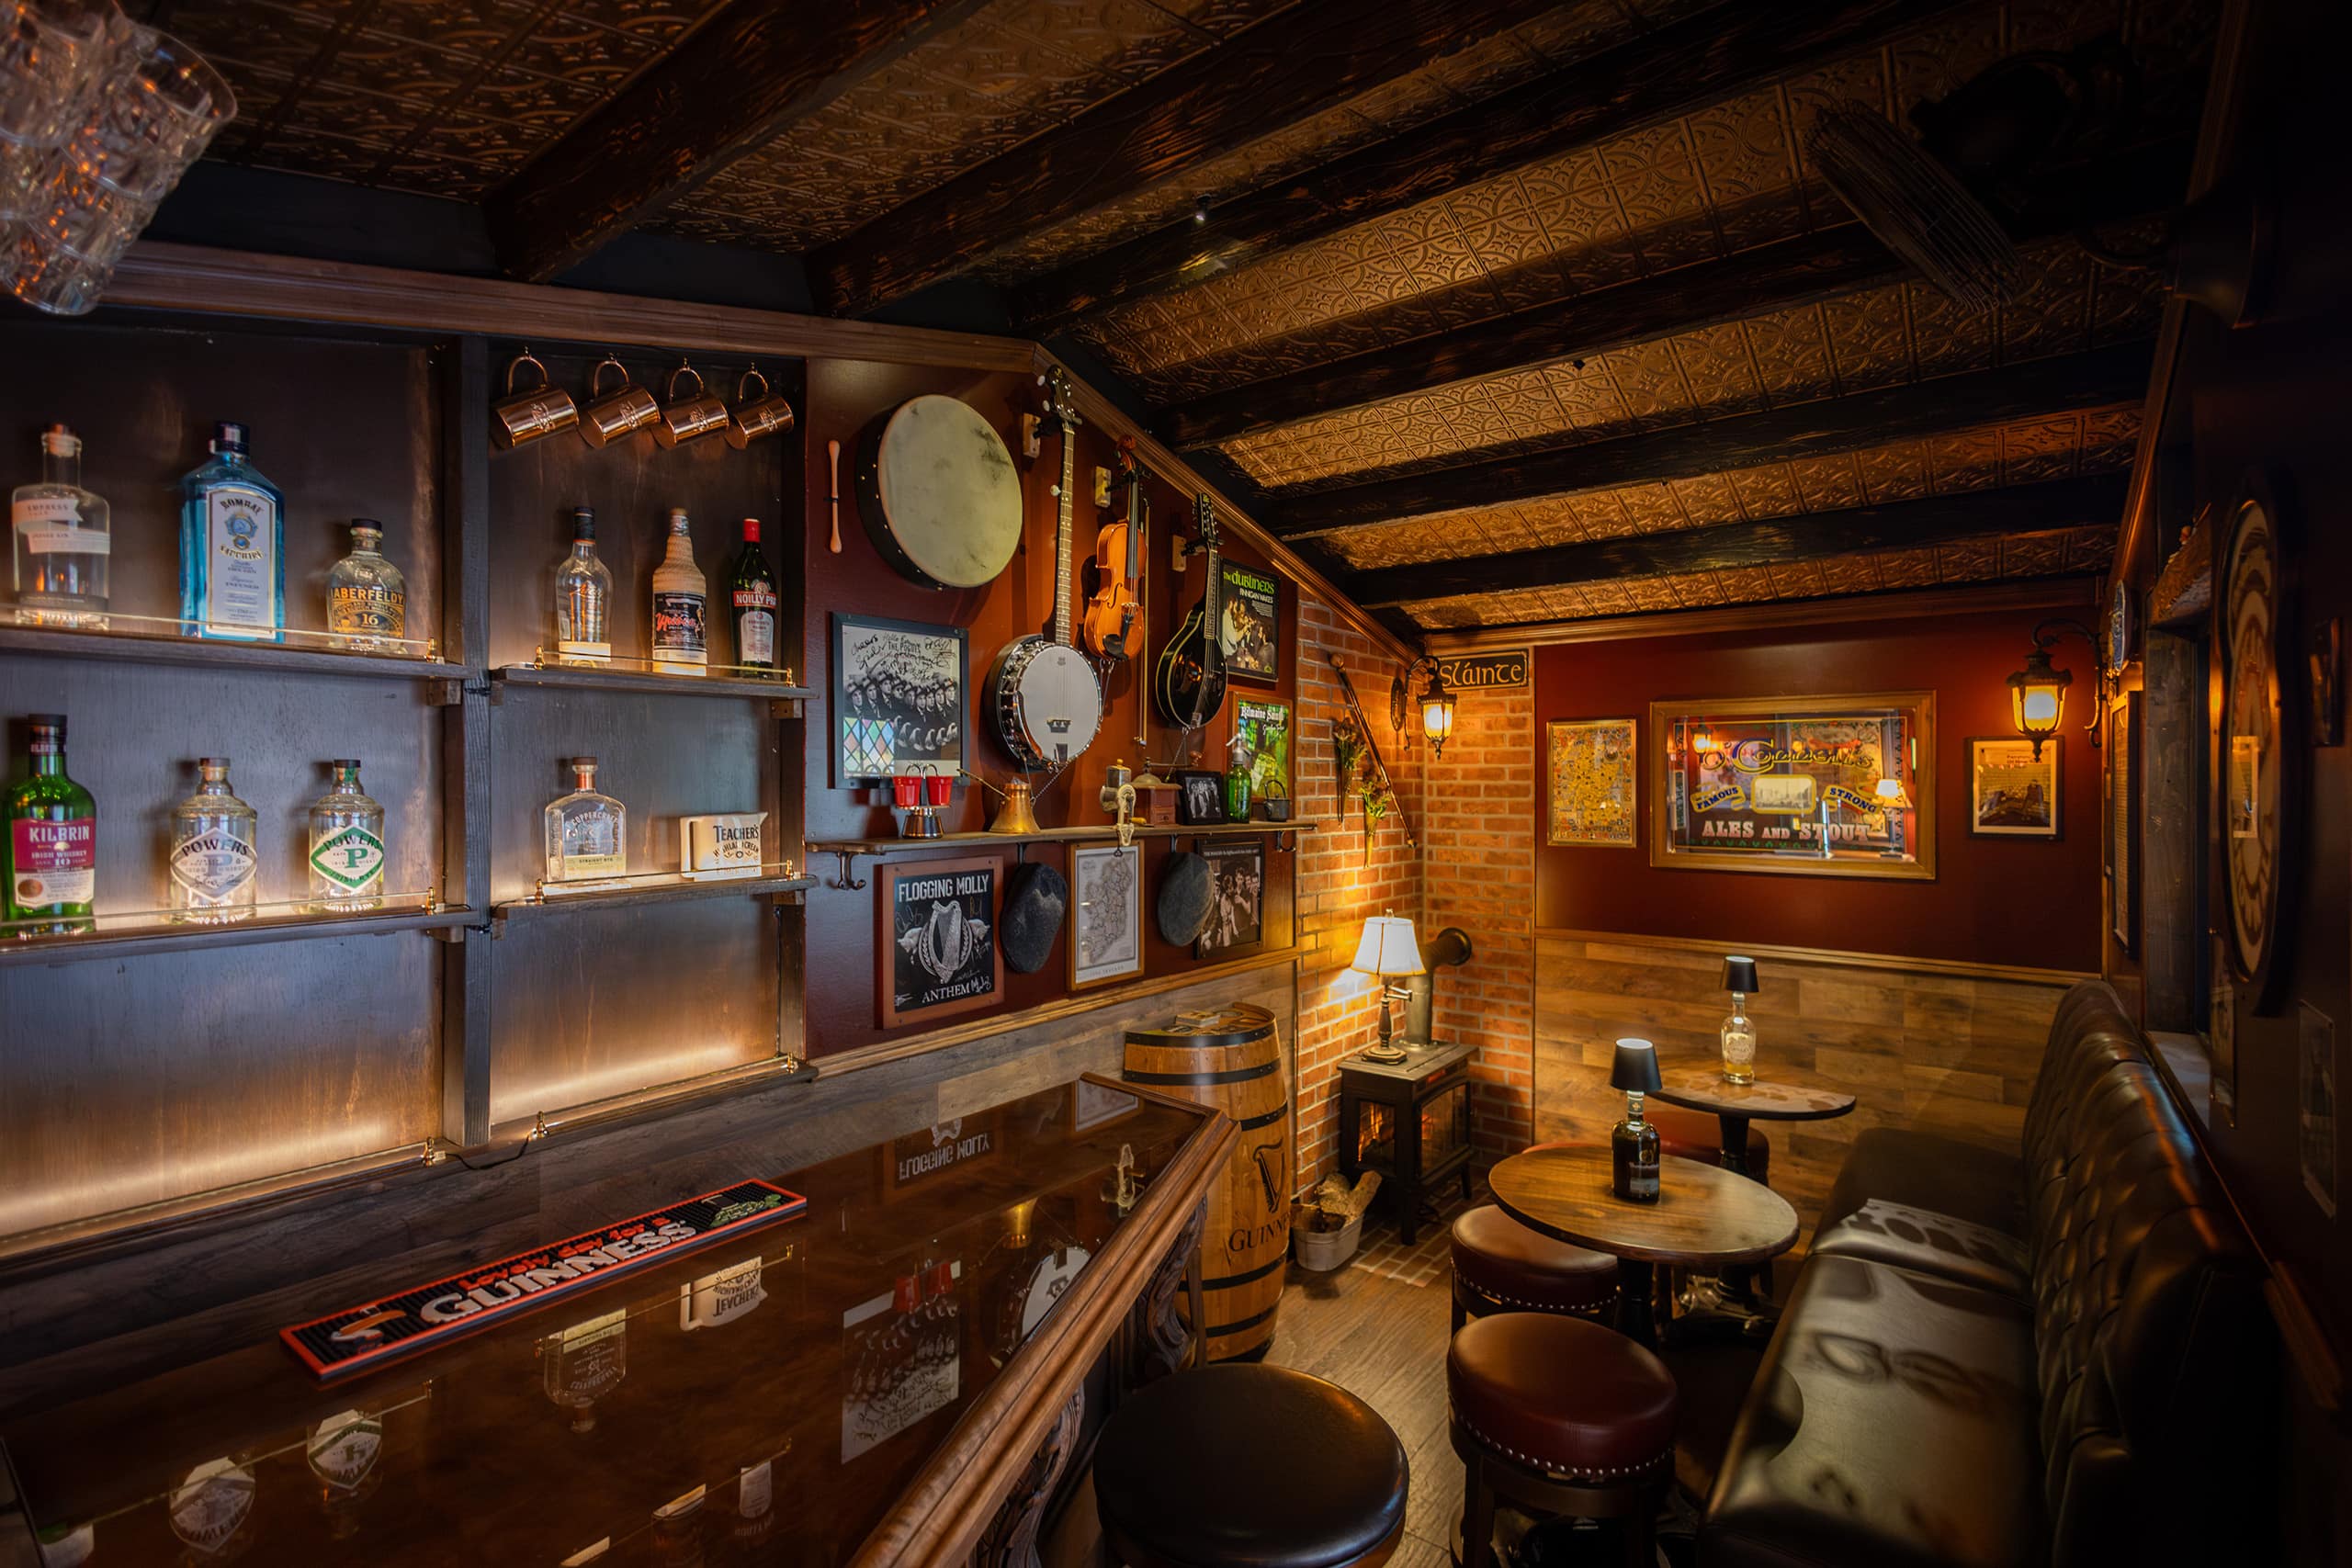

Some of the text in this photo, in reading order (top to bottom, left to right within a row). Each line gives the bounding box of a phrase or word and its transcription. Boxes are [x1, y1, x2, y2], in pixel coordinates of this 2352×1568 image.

[220, 497, 264, 516] BOMBAY
[334, 587, 404, 605] ABERFELDY
[736, 593, 764, 605] NOILLY
[361, 614, 379, 626] 16
[1439, 662, 1523, 688] Sláinte
[1696, 786, 1739, 811] FAMOUS
[1829, 786, 1878, 814] STRONG
[28, 825, 90, 843] KILBRIN
[713, 824, 759, 843] TEACHER'S
[1702, 820, 1871, 842] ALES AND STOUT
[181, 838, 250, 857] POWERS
[323, 833, 383, 852] POWERS
[54, 858, 71, 867] 10
[899, 874, 989, 903] FLOGGING MOLLY
[922, 984, 971, 1004] ANTHEM
[420, 1220, 695, 1325] GUINNESS
